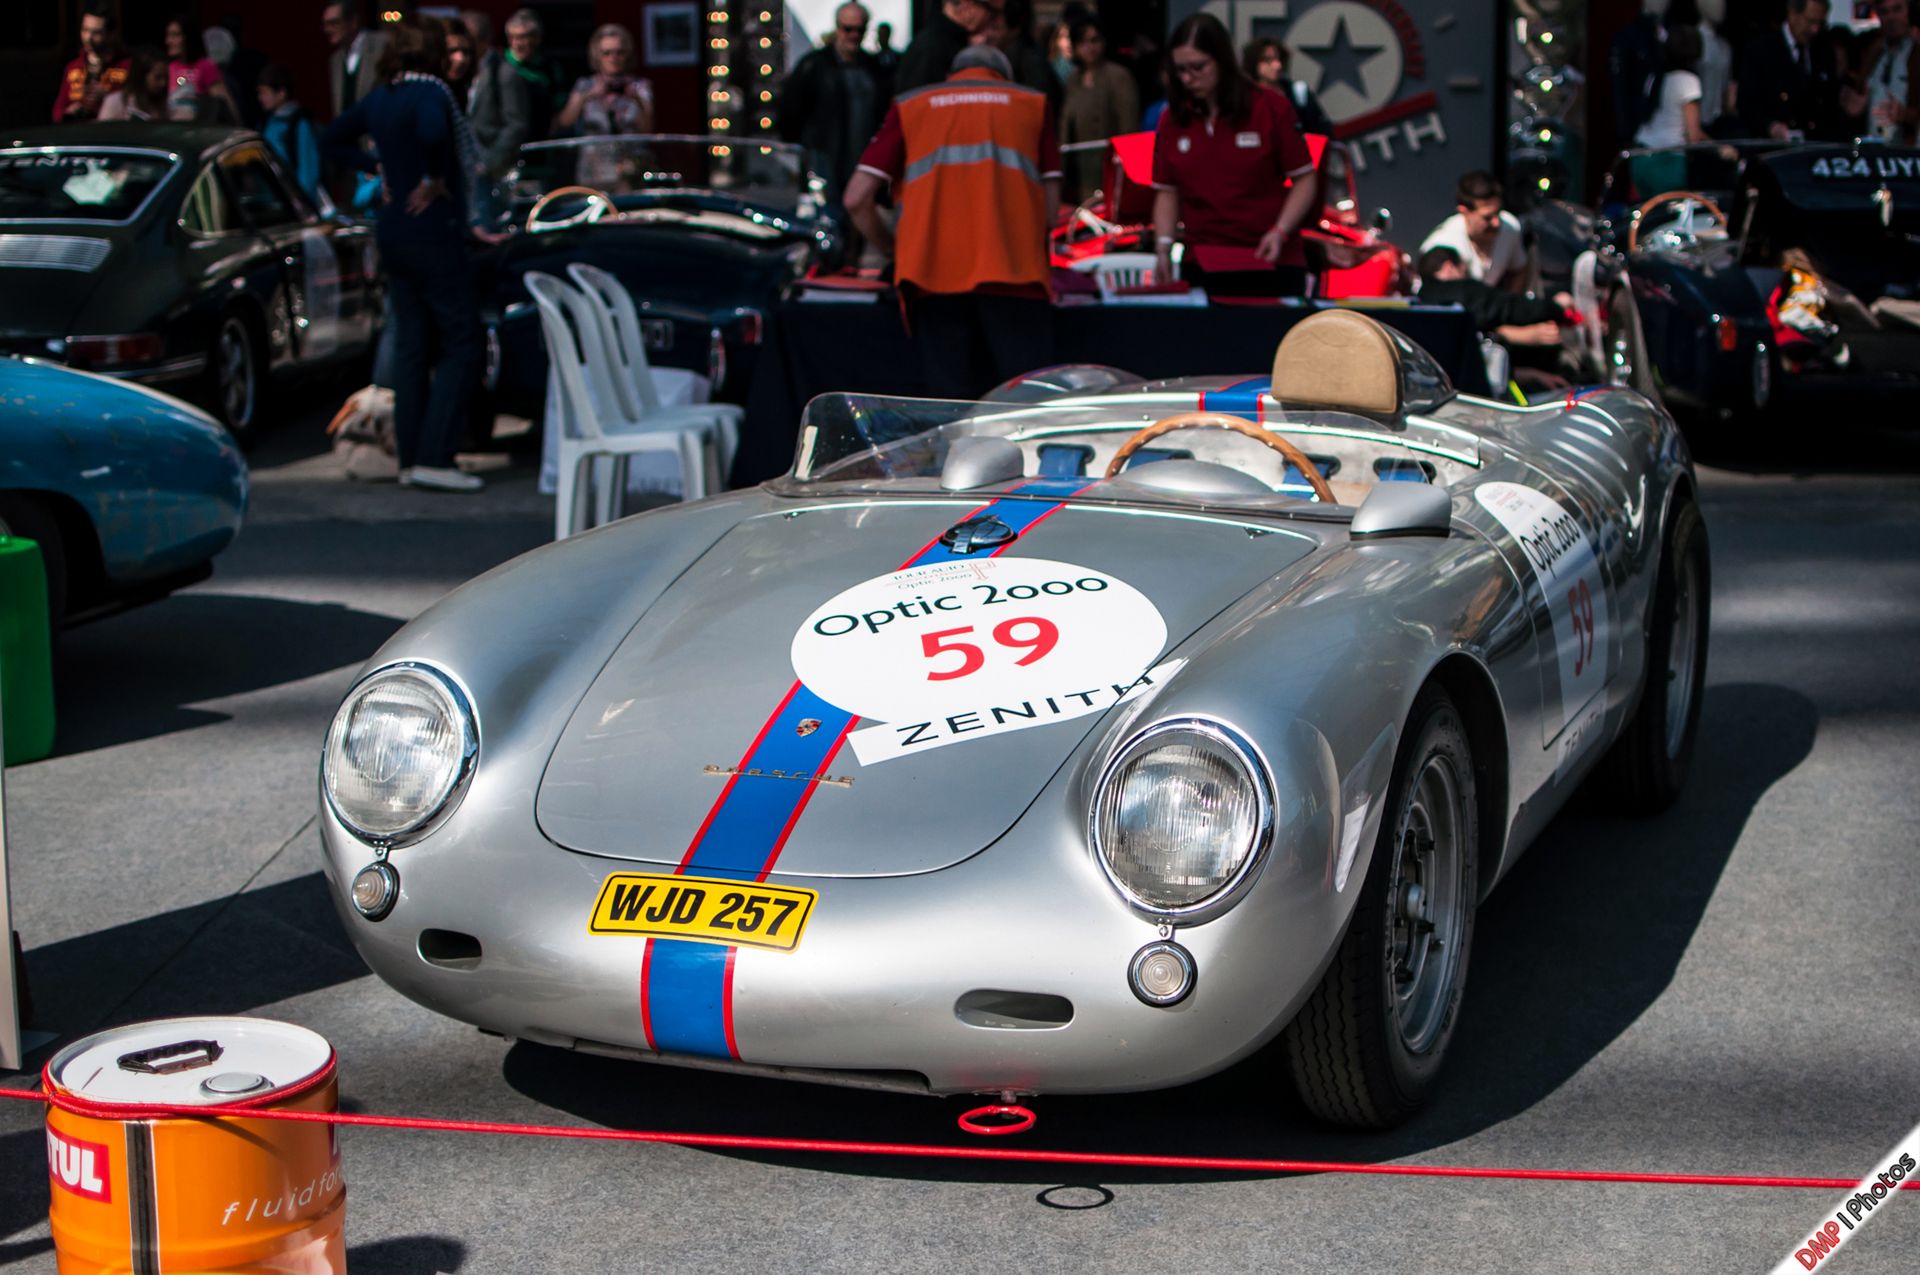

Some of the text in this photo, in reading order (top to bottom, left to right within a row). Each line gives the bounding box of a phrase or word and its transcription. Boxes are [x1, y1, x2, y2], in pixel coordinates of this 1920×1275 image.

[1811, 156, 1873, 178] 424
[813, 577, 1109, 636] Optic 2000
[1567, 578, 1594, 677] 59
[920, 616, 1059, 681] 59
[896, 676, 1155, 747] ZENITH
[609, 884, 800, 936] WJD 257
[47, 1129, 103, 1194] TUL
